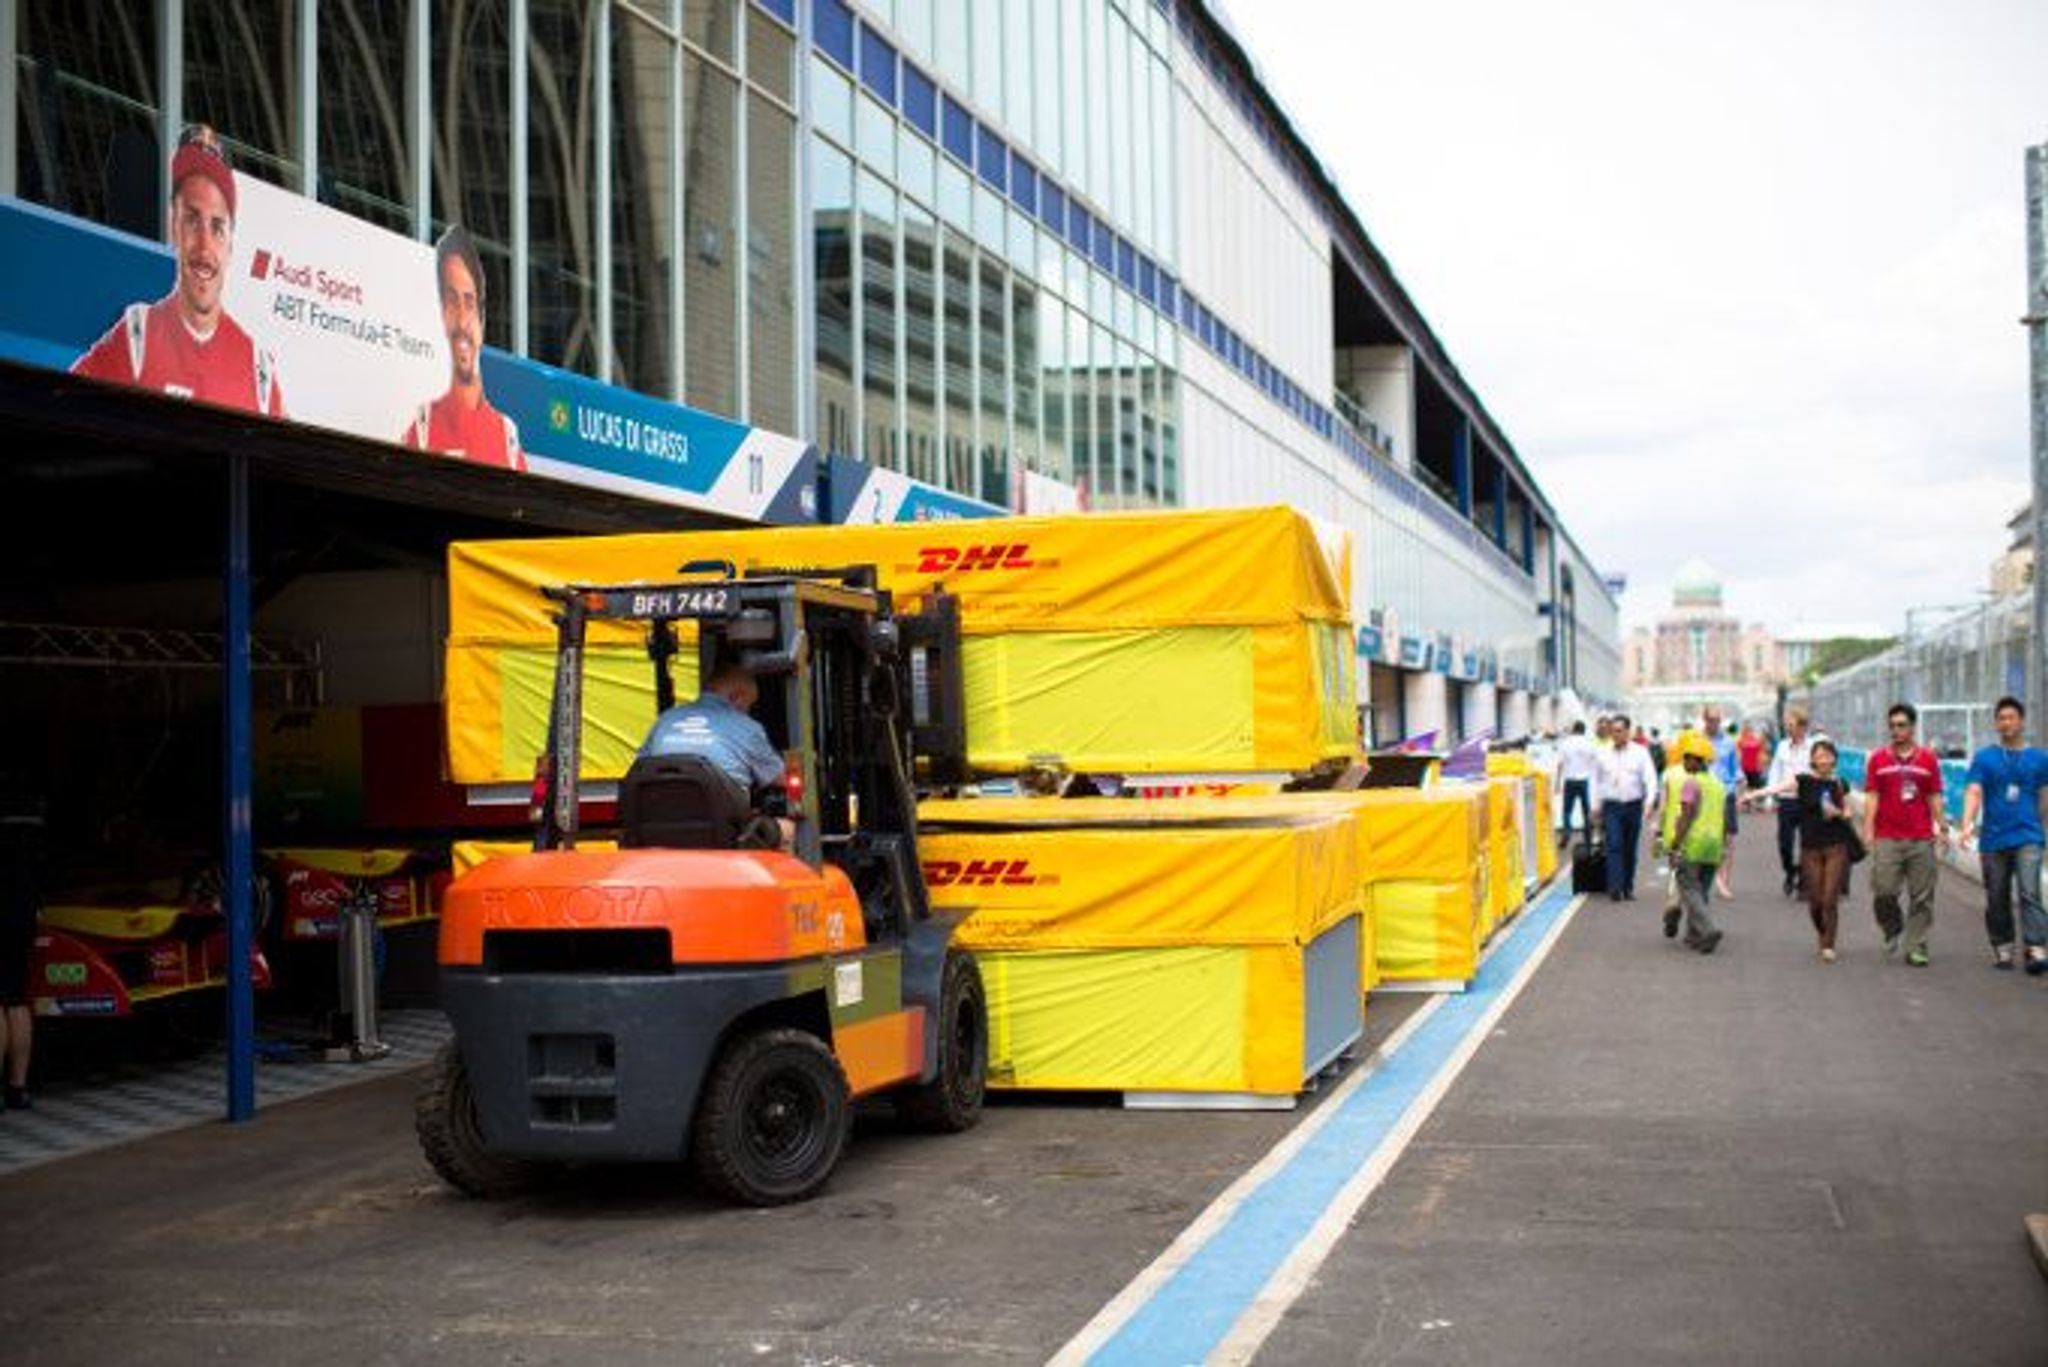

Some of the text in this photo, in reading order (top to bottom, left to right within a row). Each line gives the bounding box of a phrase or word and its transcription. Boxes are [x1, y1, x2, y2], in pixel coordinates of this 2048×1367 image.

[273, 256, 364, 304] Audi Sport
[273, 292, 306, 322] ABT
[393, 327, 435, 358] Team
[578, 405, 689, 464] LUCAS DI GRASSI
[749, 453, 763, 495] 11
[916, 545, 1035, 573] DHL
[677, 588, 728, 612] 7442
[922, 860, 1036, 886] DHL
[483, 885, 674, 927] TOYOTA
